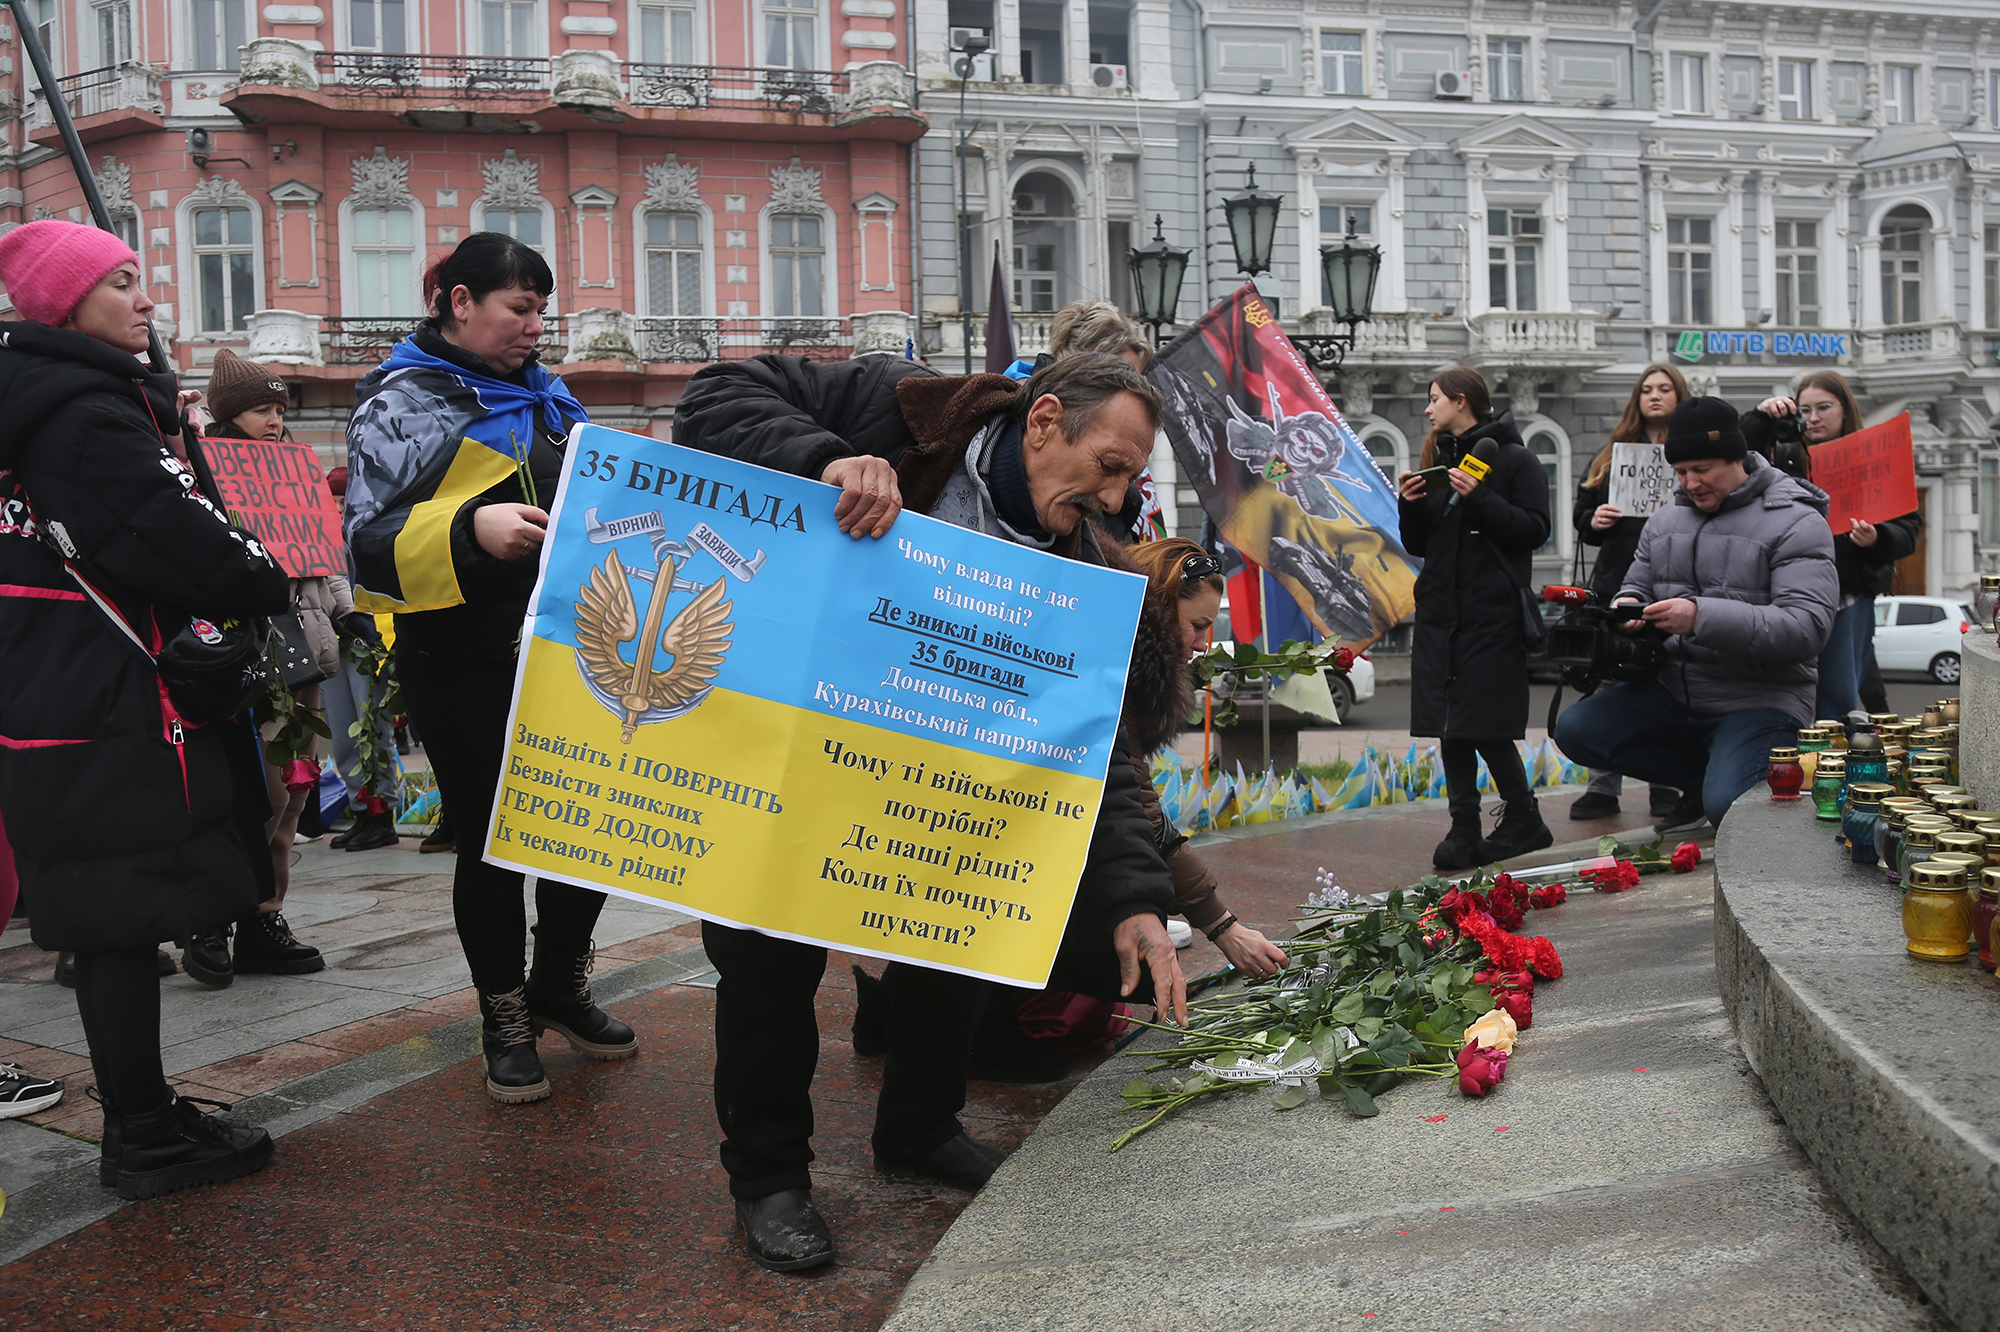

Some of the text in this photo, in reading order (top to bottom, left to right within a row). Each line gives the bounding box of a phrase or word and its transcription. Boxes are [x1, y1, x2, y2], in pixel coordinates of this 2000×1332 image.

[1707, 331, 1848, 356] MTB BANK
[200, 441, 321, 483] ОВЕРНІТЬ
[1326, 402, 1371, 459] ТАНКОВА
[1370, 459, 1400, 500] БРИГА
[1620, 464, 1663, 478] ГОЛОС
[1652, 446, 1661, 463] Я
[216, 480, 321, 509] ЕЗВІСТИ
[579, 450, 807, 534] 35 БРИГАДА
[1640, 478, 1674, 489] КОГО
[1648, 489, 1662, 499] НЕ
[236, 511, 332, 545] ИКЛИХ
[608, 511, 661, 537] ВІРНИЙ
[696, 525, 741, 568] ЗАВЖДИ
[897, 537, 1079, 611] Чому влада не дає
[933, 585, 1034, 627] відповіді?
[869, 596, 1076, 671] Де зниклі військові
[911, 640, 1026, 689] 35 бригади
[880, 665, 1039, 727] Донецька обл.,
[812, 680, 1089, 764] Курахівський напрямок?
[509, 755, 704, 826] Безвісти зниклих
[515, 723, 784, 815] Знайдіть і ПОВЕРНІТЬ
[822, 737, 1086, 820] Чому ті військові не
[502, 786, 715, 860] ГЕРОЇВ ДОДОМУ
[883, 799, 1009, 840] потрібні?
[495, 814, 687, 886] Їх чекають рідні!
[841, 823, 1035, 884] Де наші рідні?
[818, 856, 1033, 923] Коли їх почнуть
[860, 910, 977, 947] шукати?
